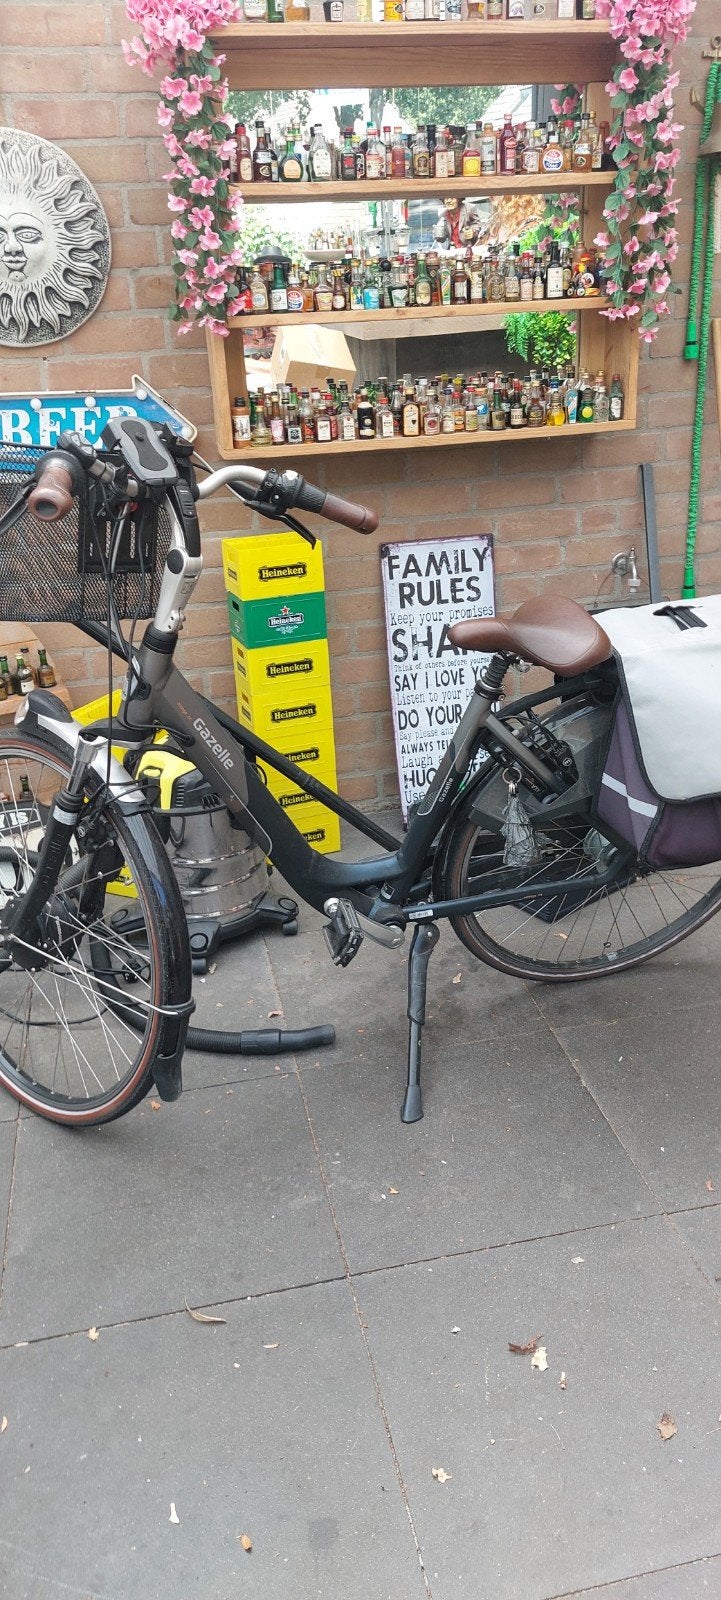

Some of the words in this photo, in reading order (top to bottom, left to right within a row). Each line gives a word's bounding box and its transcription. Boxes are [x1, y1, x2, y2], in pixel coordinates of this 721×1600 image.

[388, 547, 489, 580] FAMILY
[261, 566, 304, 578] Heineken
[399, 576, 481, 609] RULES
[270, 615, 302, 626] Heineken
[390, 612, 415, 626] Keep
[419, 611, 444, 626] your
[449, 605, 493, 620] promises
[391, 623, 468, 662] SHA
[269, 663, 310, 675] Heineken
[394, 664, 413, 672] Think
[415, 662, 422, 670] of
[424, 660, 445, 669] others
[447, 658, 468, 667] before
[394, 672, 418, 692] SAY
[435, 668, 465, 688] LOVE
[396, 691, 426, 705] Listen
[429, 692, 438, 702] to
[442, 689, 462, 704] your
[274, 708, 314, 720] Heineken
[398, 709, 419, 730] DO
[425, 703, 463, 726] YOUR
[399, 731, 412, 742] Say
[415, 729, 439, 740] please
[440, 727, 454, 736] and
[193, 718, 234, 770] Gazelle
[401, 741, 434, 754] ALWAYS
[286, 751, 317, 762] ineken
[401, 754, 433, 769] Laugh
